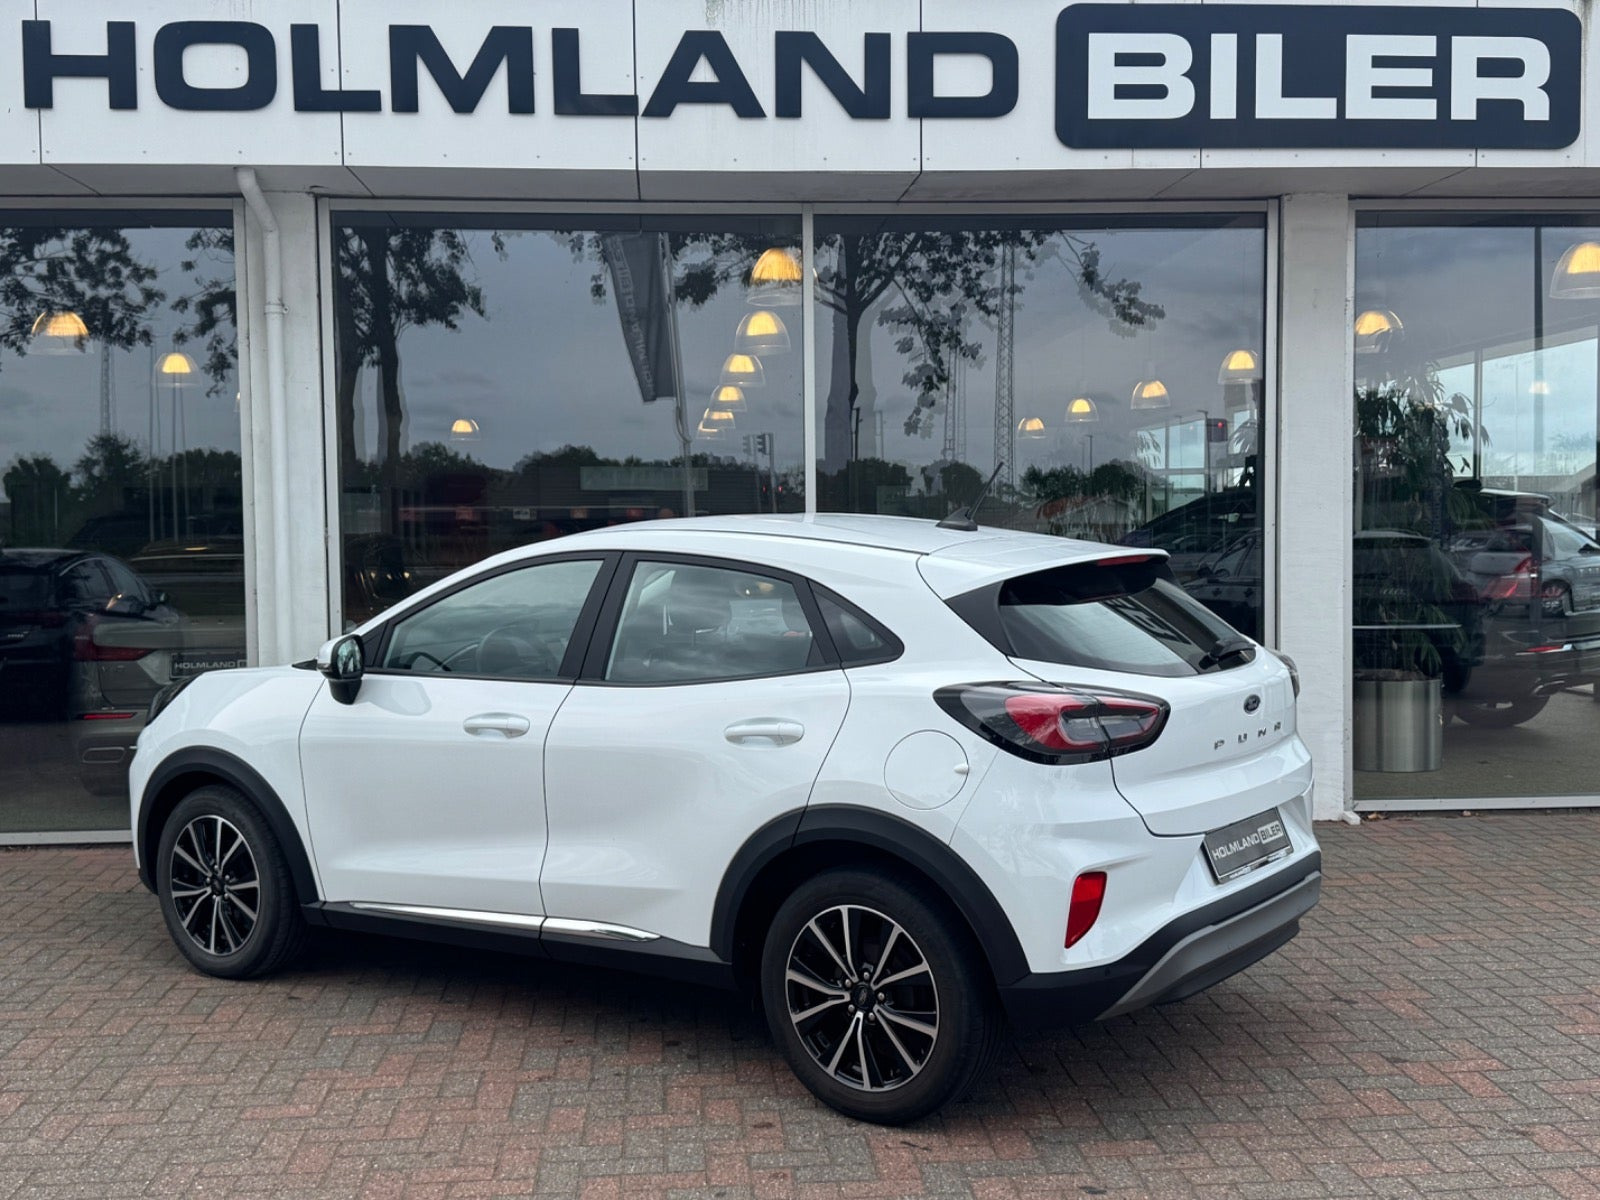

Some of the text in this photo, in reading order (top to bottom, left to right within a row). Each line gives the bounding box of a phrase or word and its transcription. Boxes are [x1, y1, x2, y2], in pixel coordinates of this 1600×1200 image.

[22, 20, 1551, 121] HOLMLAND BILER
[175, 661, 236, 669] HOLMLAND
[1211, 832, 1260, 860] HOLMLAND
[1260, 823, 1281, 840] BILER
